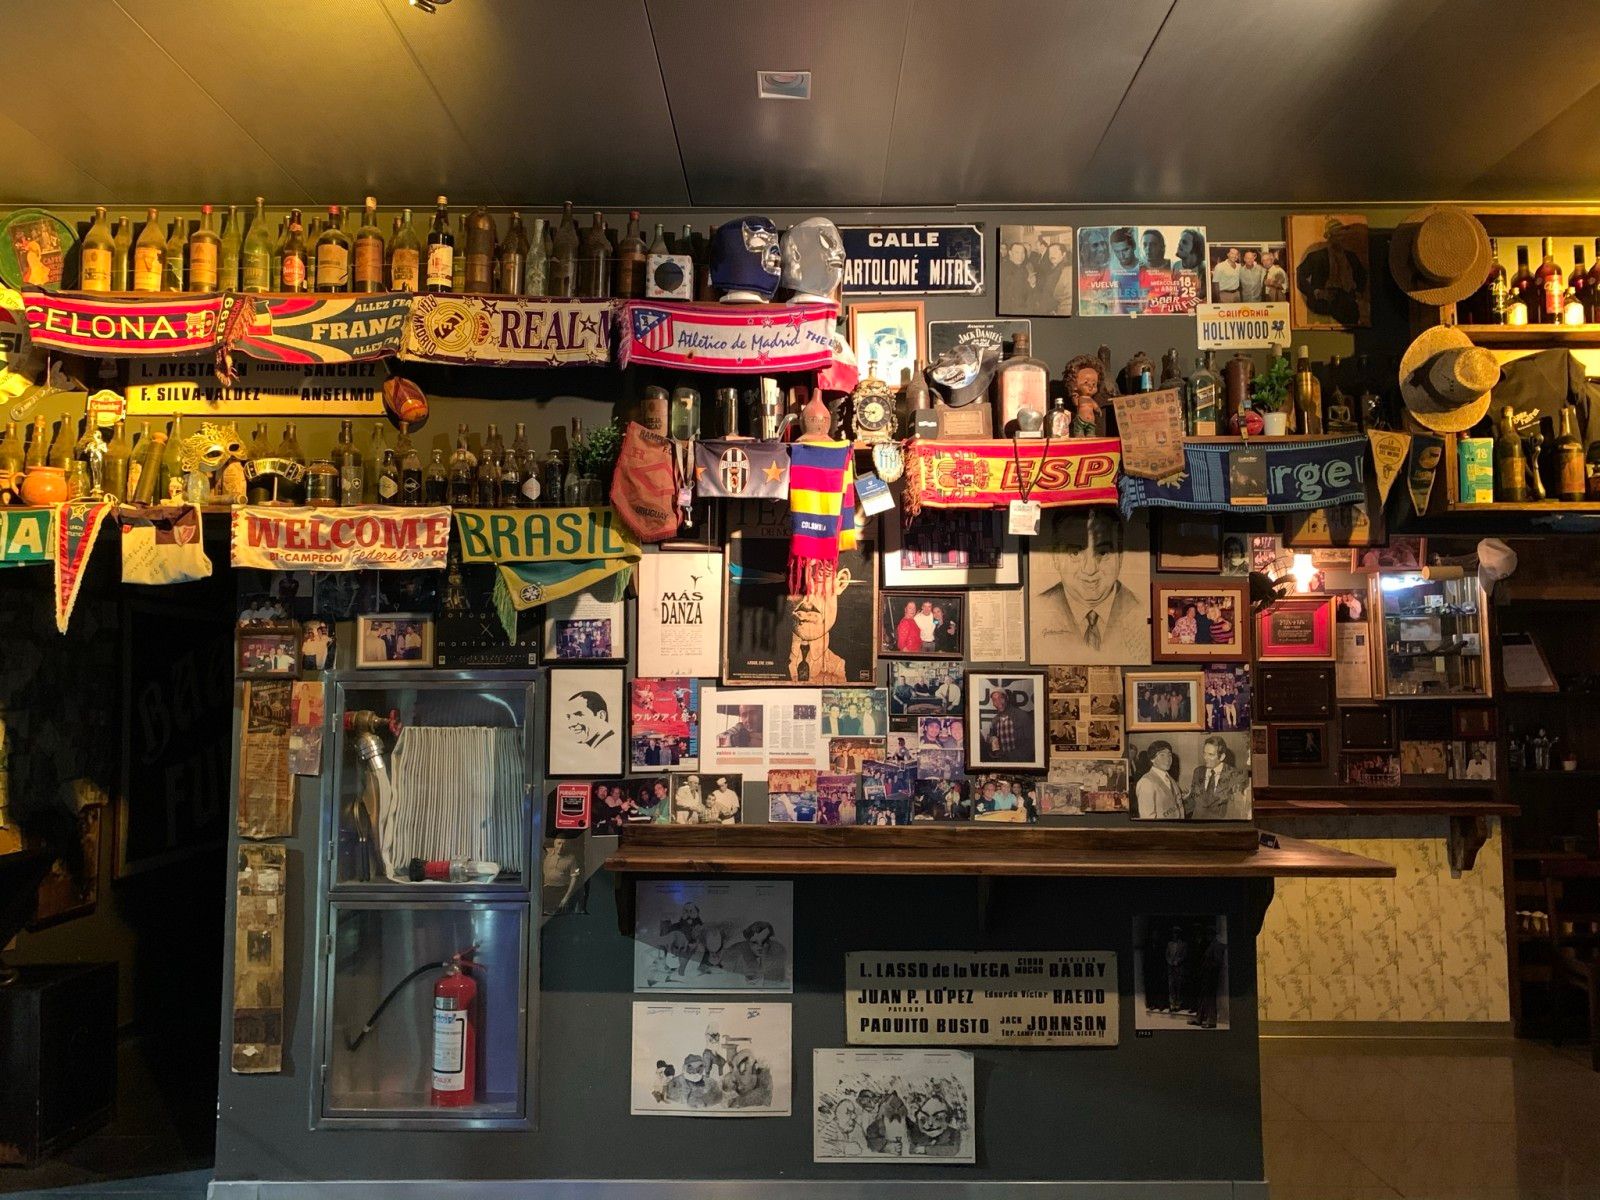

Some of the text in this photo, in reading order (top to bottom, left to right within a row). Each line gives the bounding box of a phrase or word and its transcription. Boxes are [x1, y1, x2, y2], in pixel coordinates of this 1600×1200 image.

[868, 232, 940, 248] CALLE
[844, 253, 972, 286] ARTOLOMÉ MITRE
[1179, 276, 1192, 287] 18
[1181, 287, 1197, 298] 25
[355, 301, 390, 313] ALLEZ
[1218, 309, 1269, 318] CALIFORNIA
[500, 309, 586, 350] REAL
[958, 331, 977, 344] JACK
[1203, 321, 1269, 341] HOLLYWOOD
[678, 329, 727, 350] Atlético
[730, 335, 747, 350] de
[752, 329, 800, 350] Madrid
[805, 330, 828, 346] THE
[141, 362, 153, 378] L.
[158, 360, 249, 378] AYESTAN
[141, 387, 152, 401] F.
[301, 387, 375, 401] ANSELMO
[636, 503, 669, 521] URUGUAY
[245, 516, 449, 551] WELCOME
[458, 510, 625, 558] BRASIL
[352, 549, 409, 563] Federal
[661, 589, 704, 601] MÁS
[661, 602, 703, 625] DANZA
[859, 963, 1106, 978] L. LASSO de la VEGA BARRY
[858, 989, 902, 1004] JUAN
[907, 989, 919, 1004] P.
[1053, 989, 1105, 1004] HAEDO
[860, 1015, 1107, 1034] PAQUITO BUSTO JACK JOHNSON
